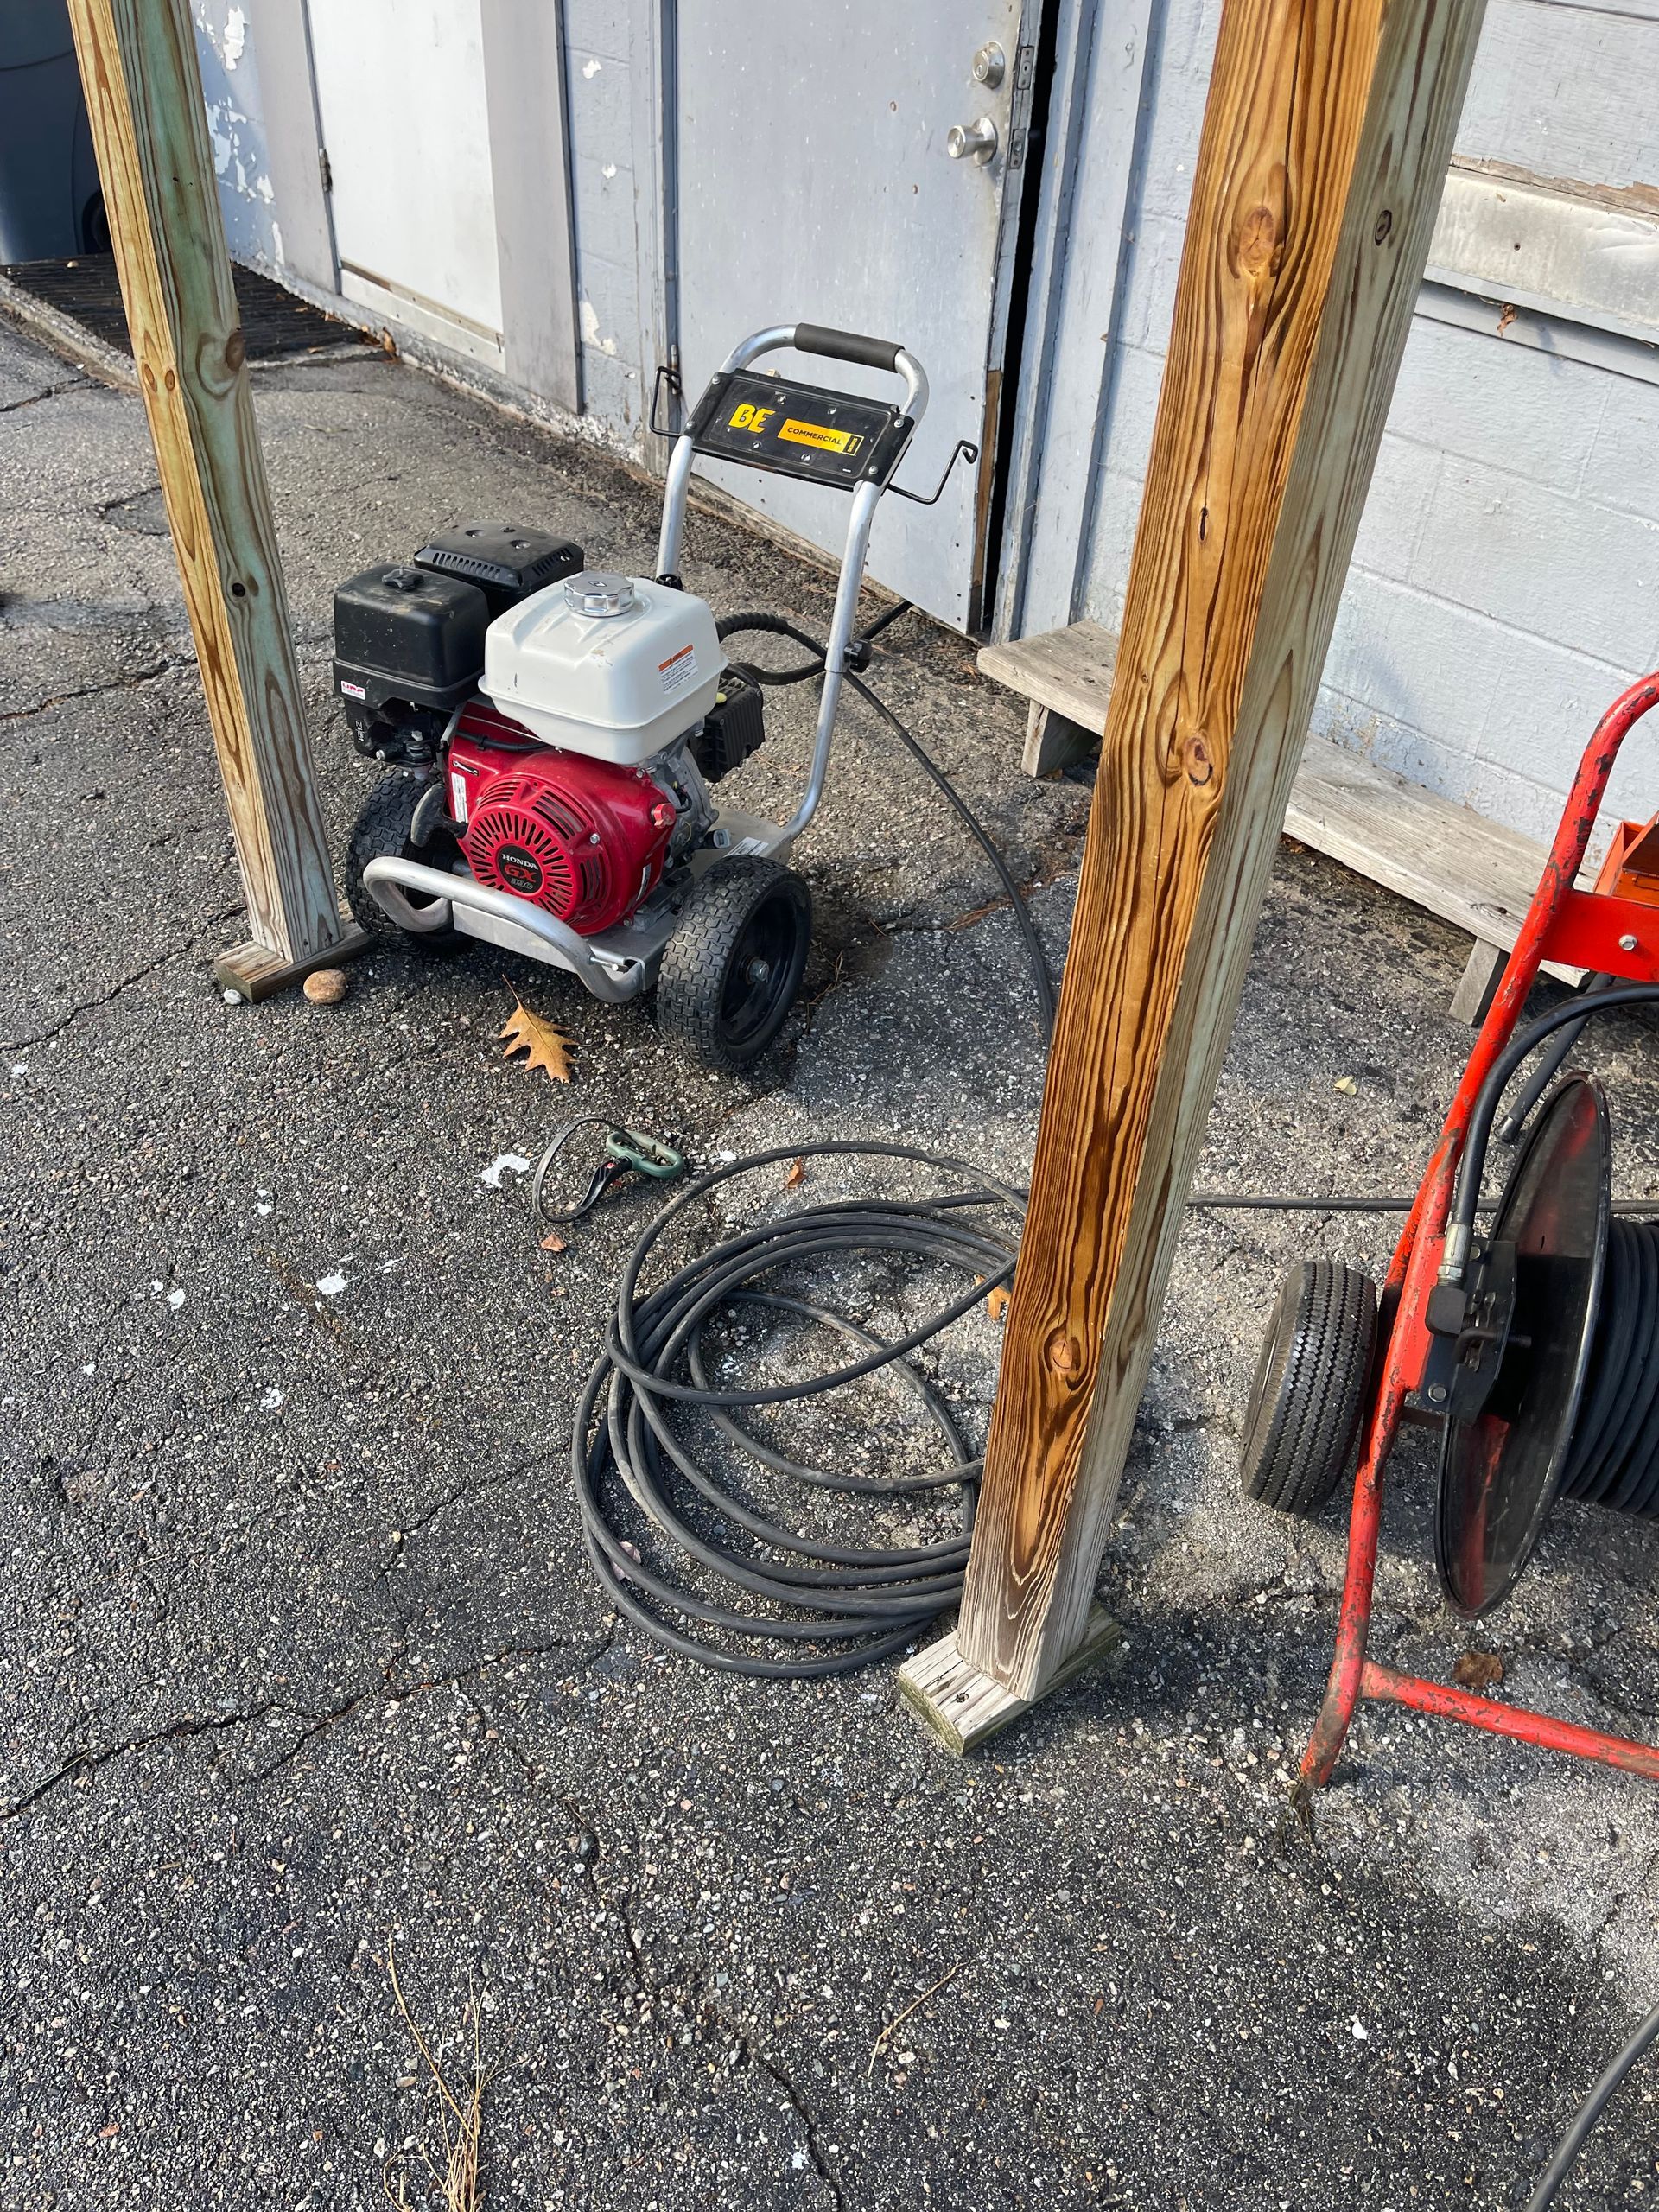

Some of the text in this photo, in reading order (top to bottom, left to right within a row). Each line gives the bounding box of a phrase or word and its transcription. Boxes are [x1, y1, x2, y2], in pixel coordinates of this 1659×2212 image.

[728, 403, 775, 433] BE
[786, 427, 842, 445] COMMERCIAL
[501, 854, 538, 870] HONDA
[504, 863, 537, 882] GX
